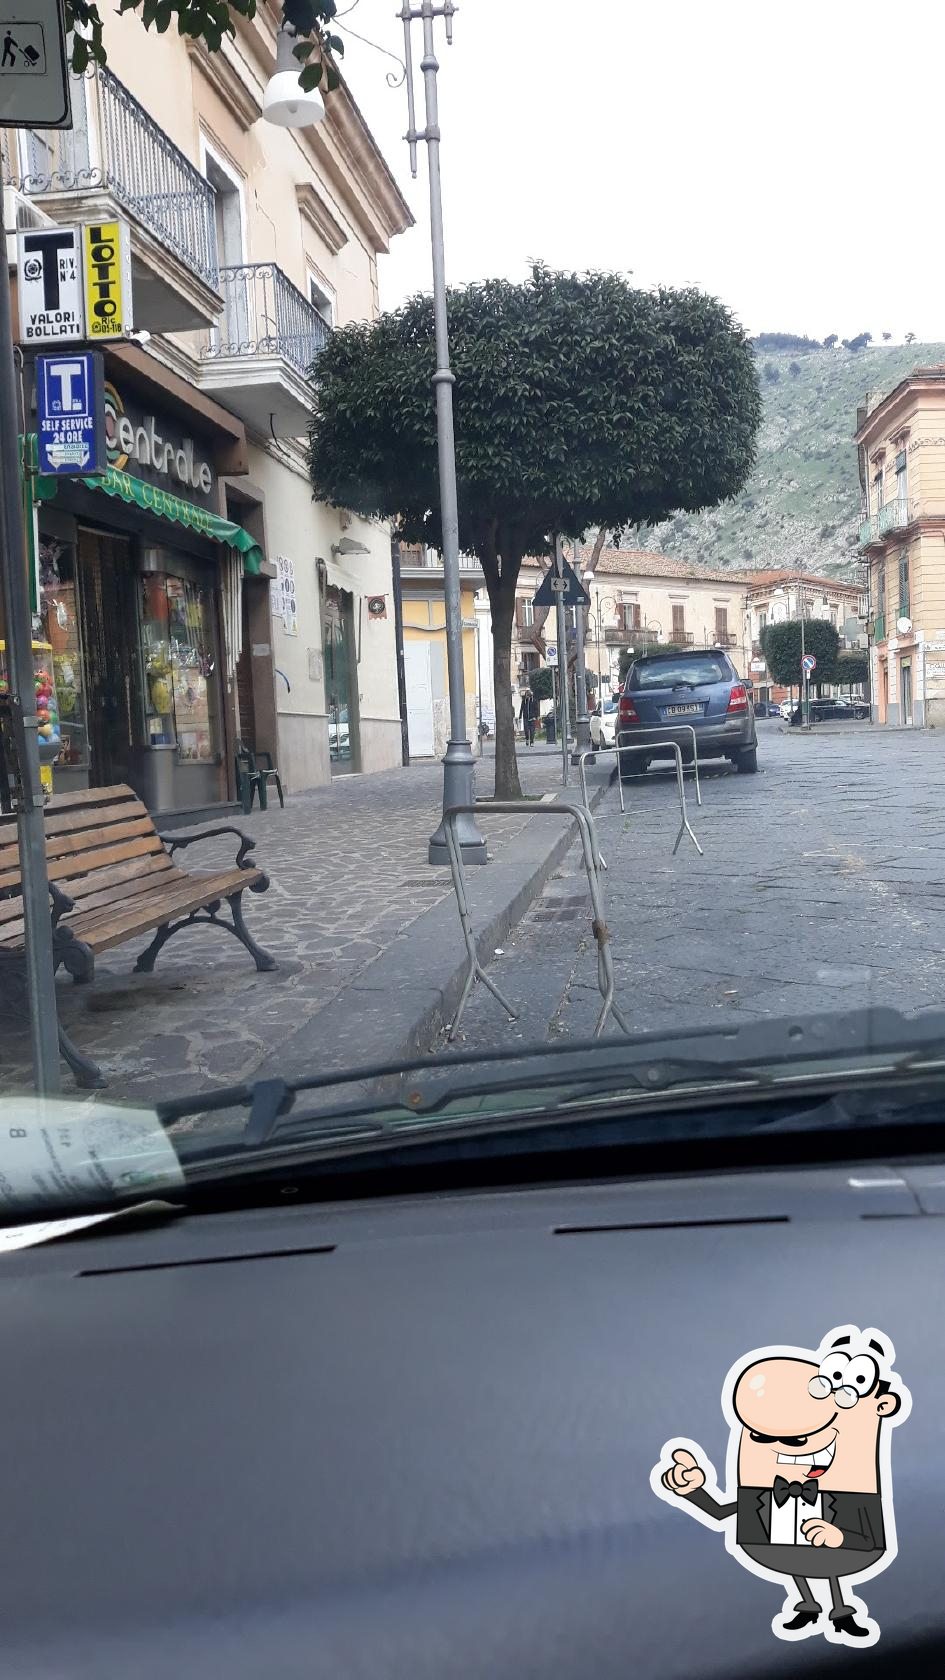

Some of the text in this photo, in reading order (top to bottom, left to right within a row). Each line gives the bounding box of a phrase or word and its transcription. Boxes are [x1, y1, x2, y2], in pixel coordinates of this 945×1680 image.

[24, 231, 74, 311] T
[89, 226, 117, 318] LOTTO
[30, 311, 75, 326] VALORI
[26, 323, 80, 338] BOLLATI
[41, 416, 93, 432] SELF SERVICE
[53, 430, 83, 443] 24 ORE
[101, 471, 213, 531] BAR CENTRALE
